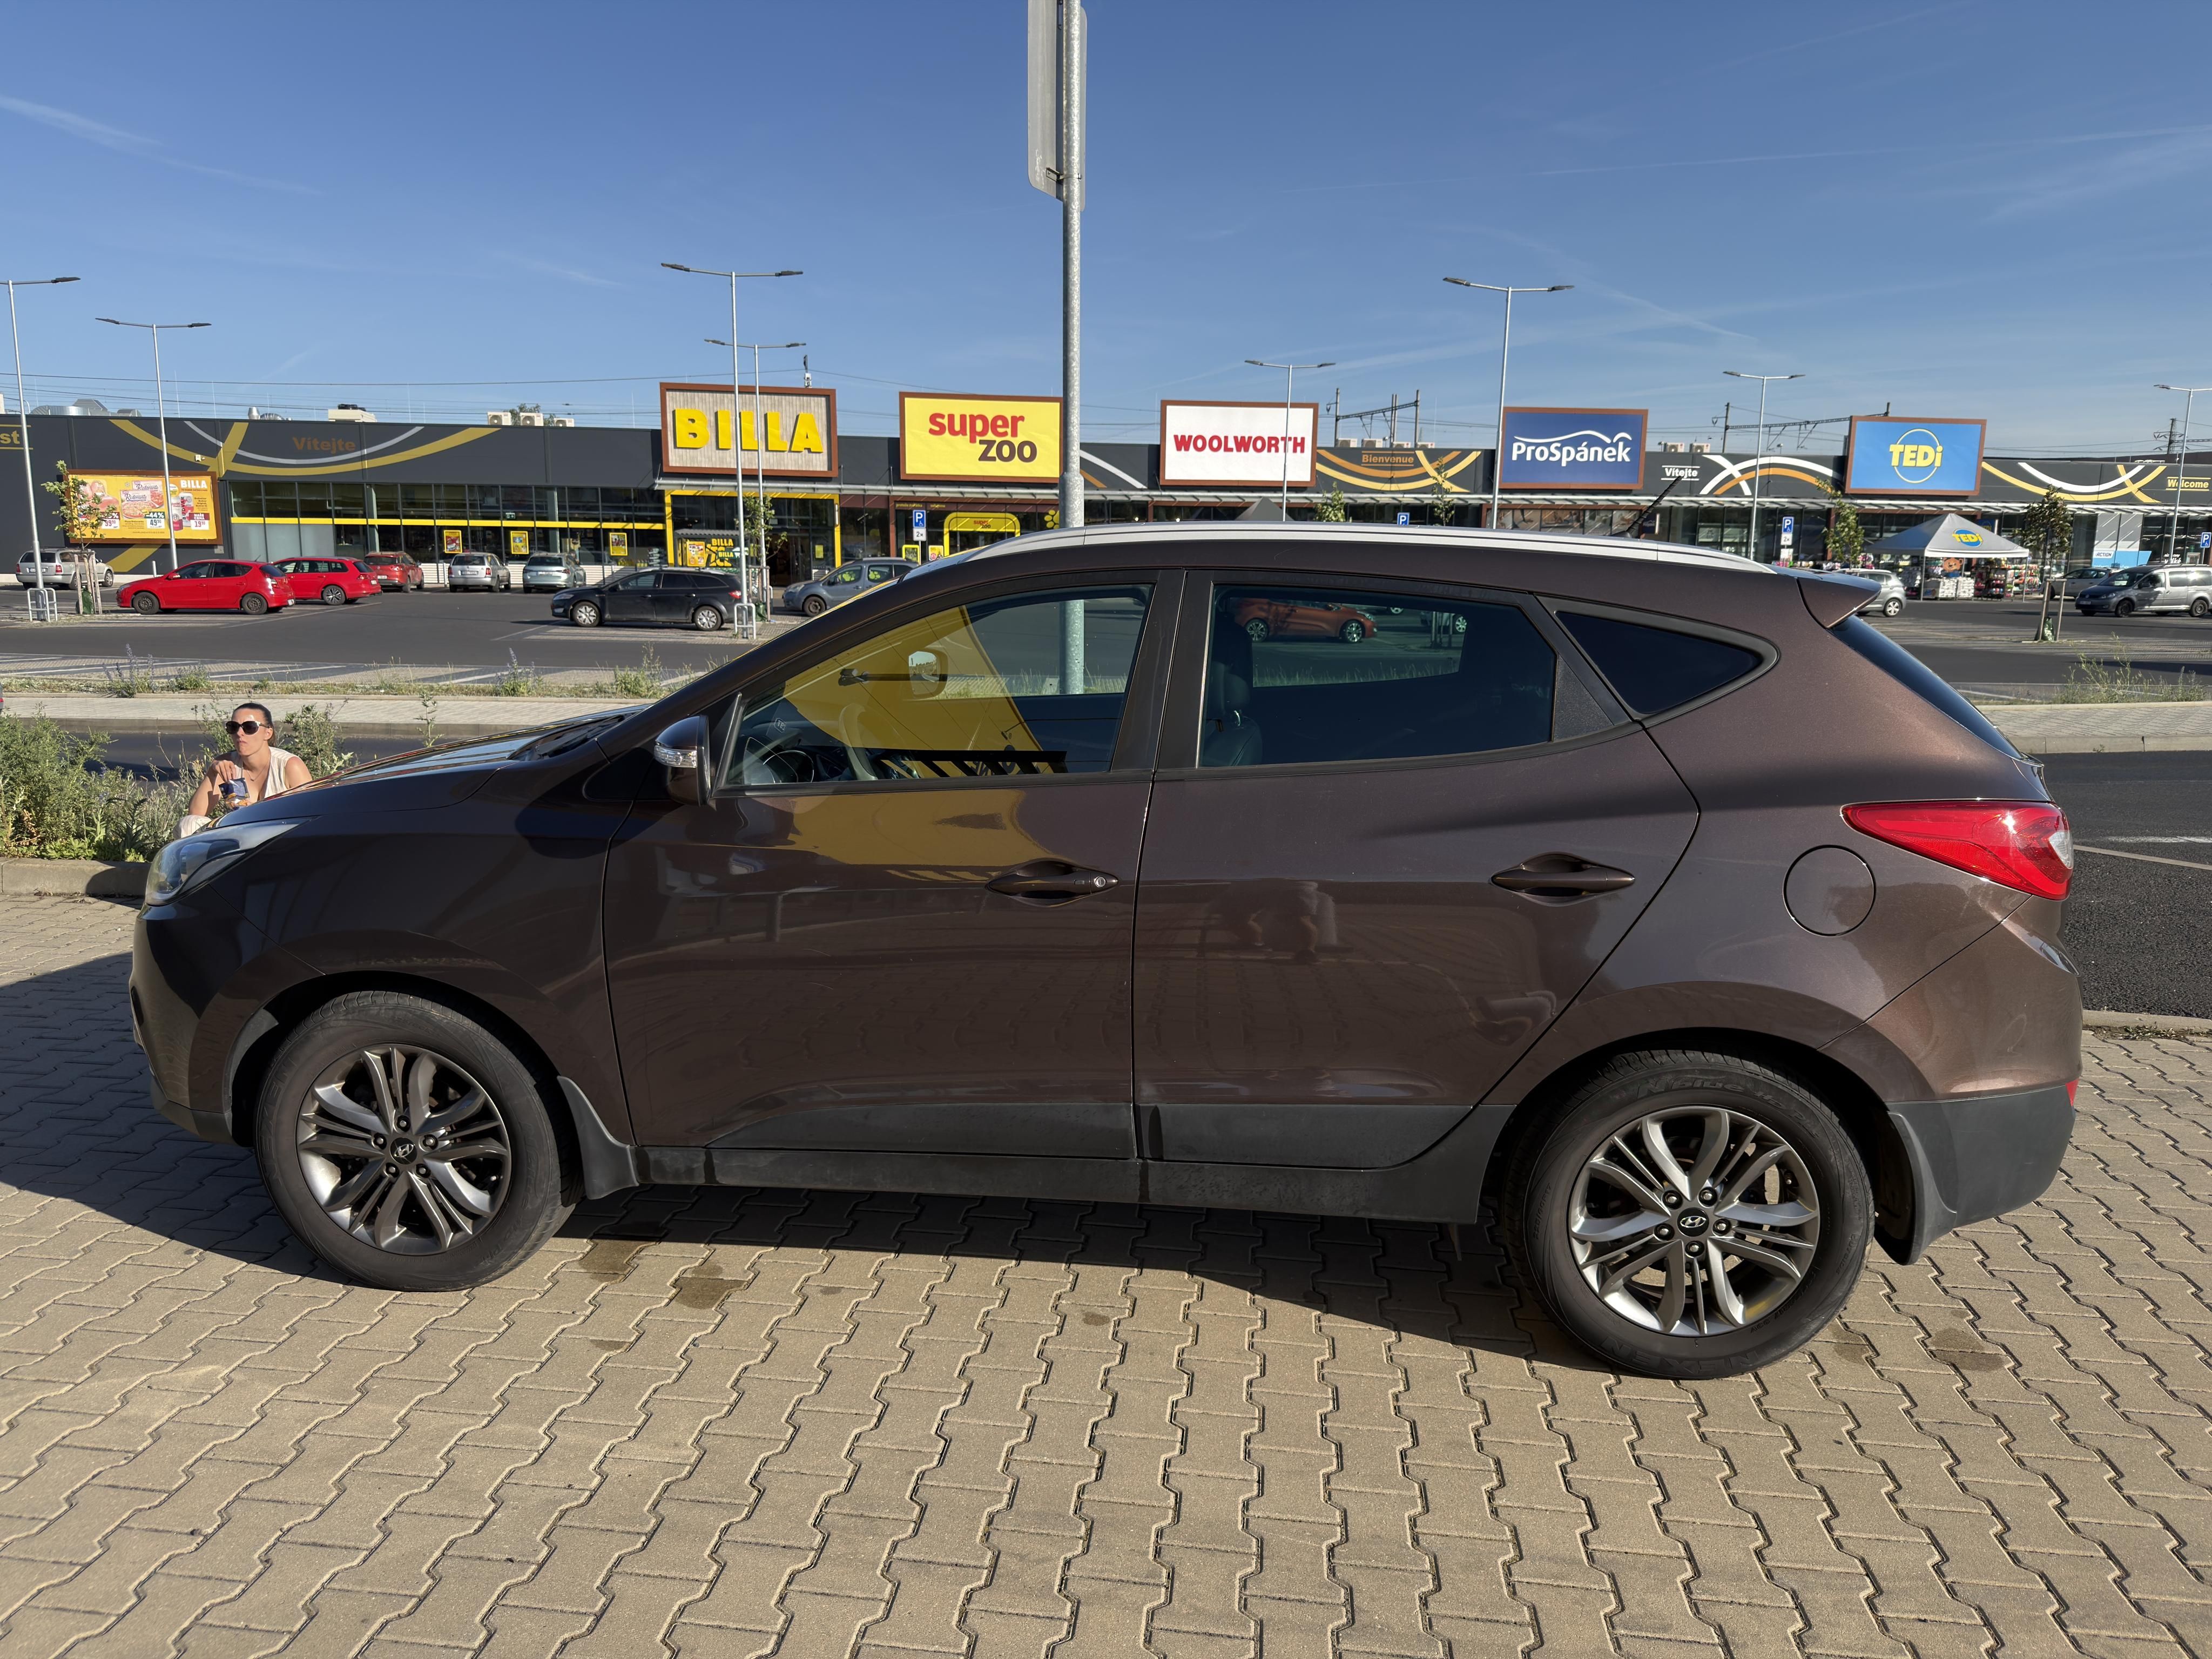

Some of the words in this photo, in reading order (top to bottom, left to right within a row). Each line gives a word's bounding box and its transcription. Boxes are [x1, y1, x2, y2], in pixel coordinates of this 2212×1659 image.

[675, 408, 824, 453] BILLA
[929, 413, 1024, 443] super
[292, 436, 356, 454] Vítejte
[1174, 435, 1305, 453] WOOLWORTH
[978, 439, 1037, 463] zoo
[1512, 441, 1630, 467] ProSpánek
[1889, 444, 1943, 467] TEDi
[1361, 454, 1414, 464] Bienvenue
[1664, 468, 1698, 478] Vítejte
[180, 480, 208, 489] BILLA
[915, 512, 923, 523] P
[1400, 515, 1407, 525] P
[1784, 519, 1791, 529] P
[712, 538, 734, 547] BILLA
[1952, 532, 1984, 543] TEDi
[2203, 534, 2209, 543] P
